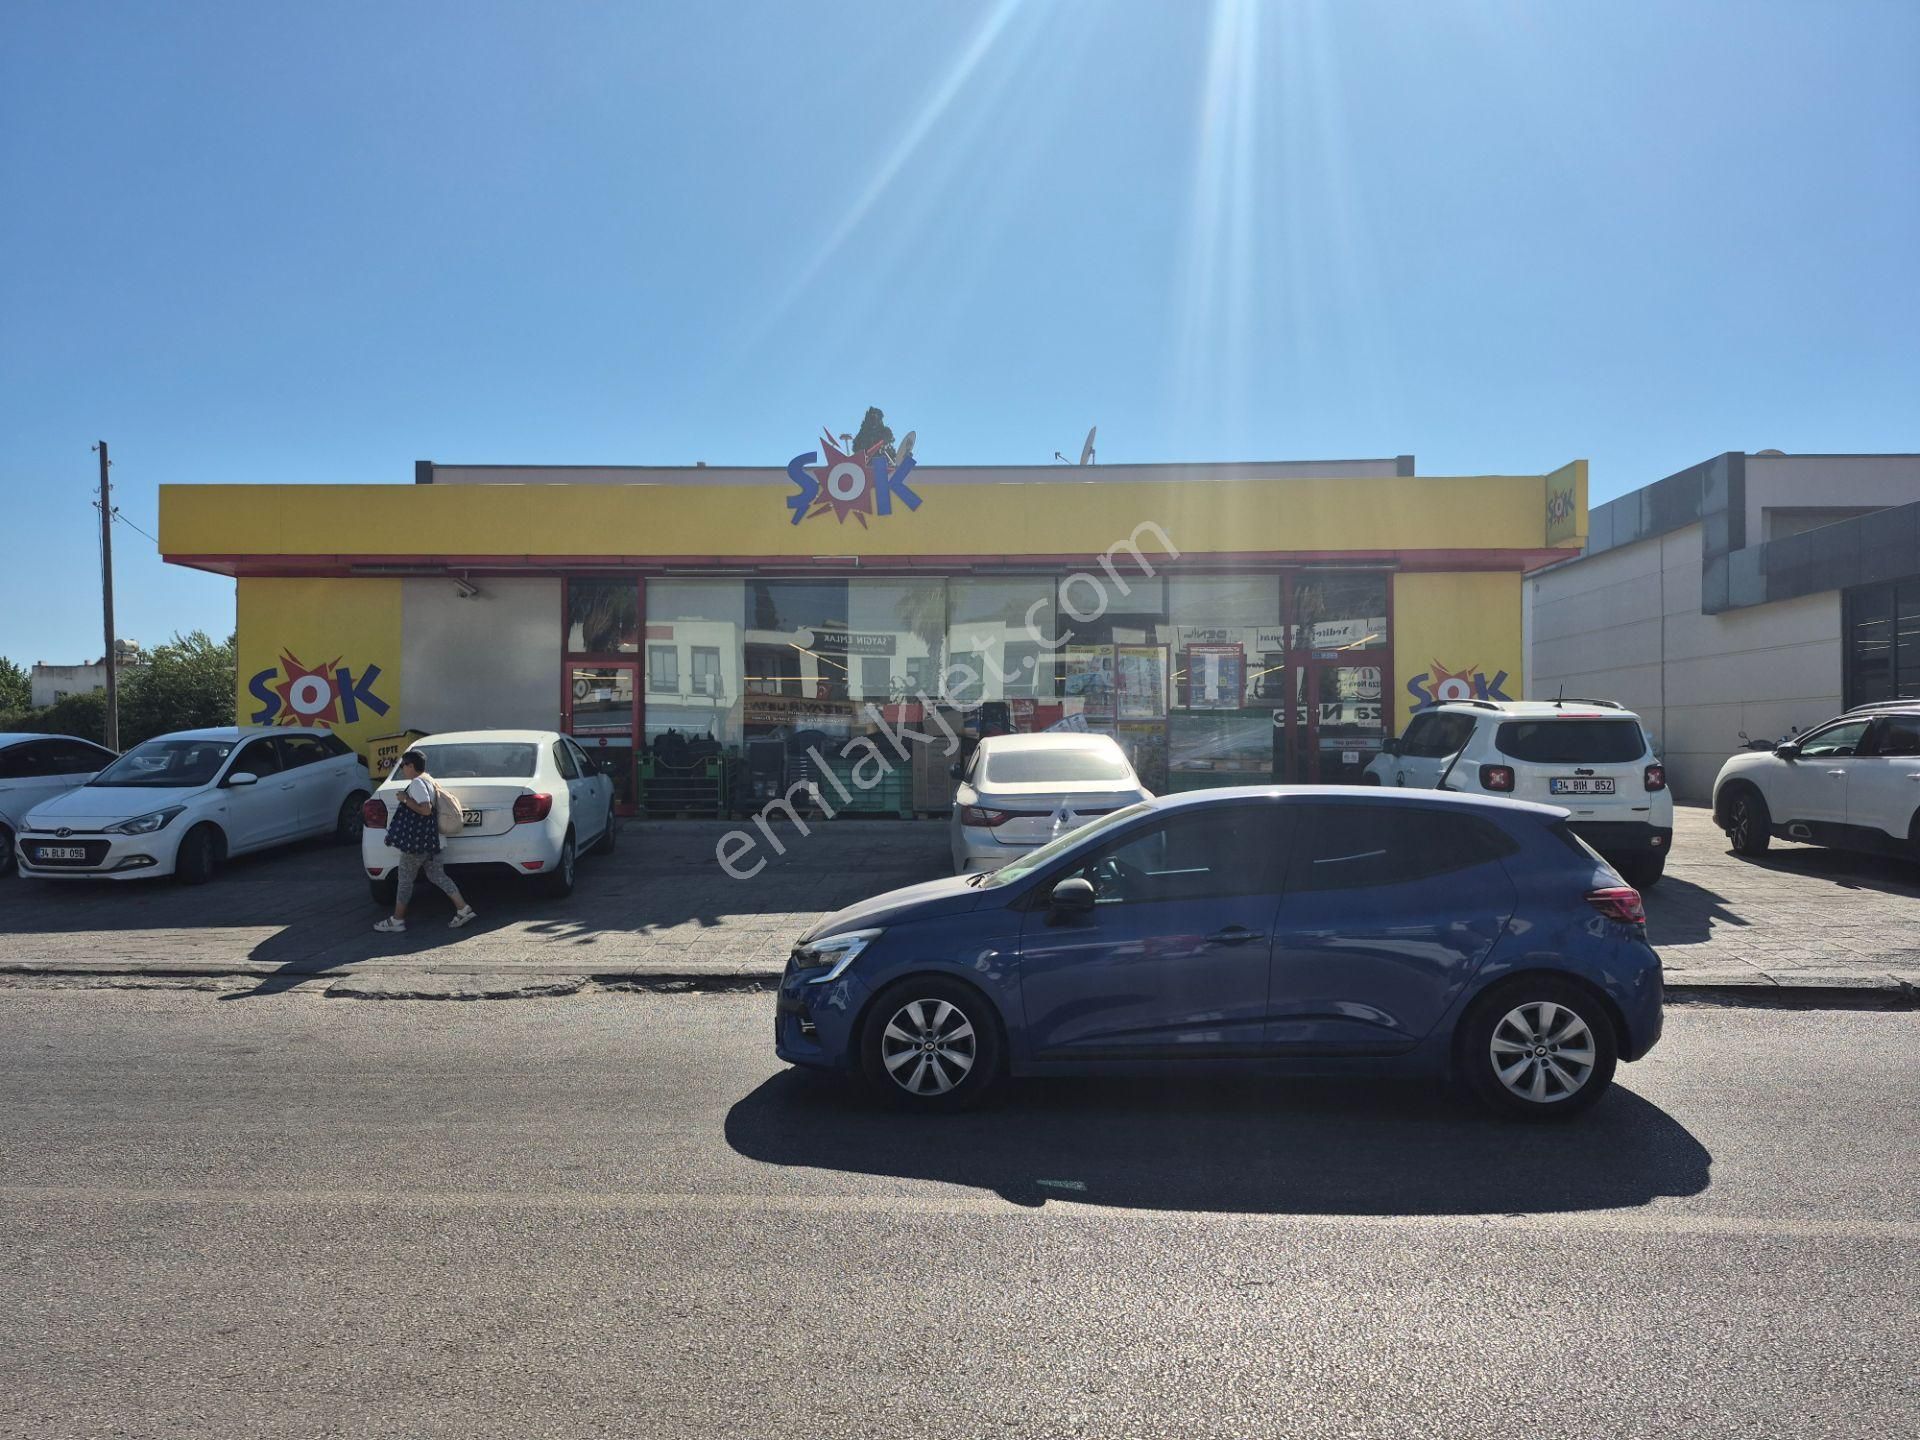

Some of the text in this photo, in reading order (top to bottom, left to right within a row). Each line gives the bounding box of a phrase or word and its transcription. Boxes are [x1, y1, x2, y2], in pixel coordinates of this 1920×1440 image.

[786, 451, 923, 525] ŞOK
[249, 664, 390, 726] ŞOK
[378, 745, 398, 756] CEPTE
[1574, 767, 1595, 776] Jeep
[1557, 780, 1612, 790] 34 BIH 852
[40, 848, 49, 858] 34
